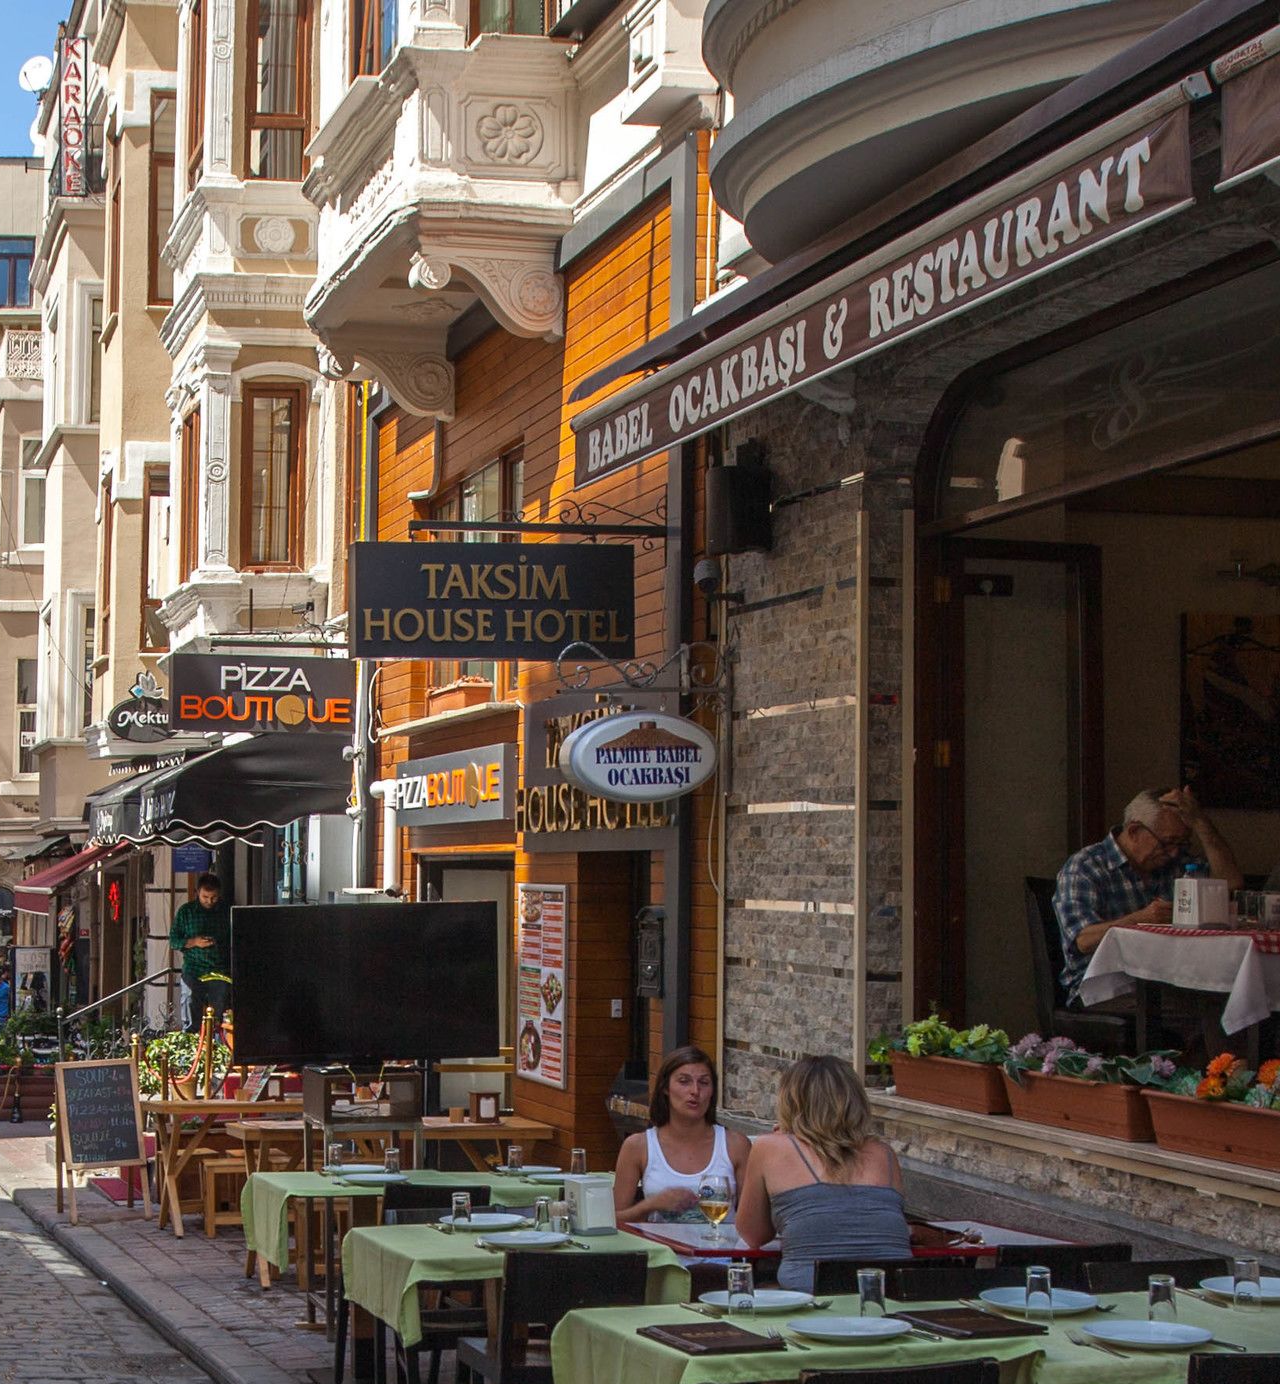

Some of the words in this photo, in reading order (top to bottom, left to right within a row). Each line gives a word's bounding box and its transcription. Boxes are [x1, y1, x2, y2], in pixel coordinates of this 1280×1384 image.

[63, 38, 84, 193] KARAOKE
[587, 403, 653, 473] BABEL
[669, 319, 807, 433] OCAKBAŞI
[822, 297, 848, 360] &
[869, 136, 1151, 339] RESTAURANT
[420, 555, 570, 600] TAKSİM
[362, 607, 496, 643] HOUSE
[505, 608, 630, 644] HOTEL
[221, 663, 312, 692] PİZZA
[656, 746, 702, 764] BABEL
[608, 767, 691, 788] OCAKBAŞI
